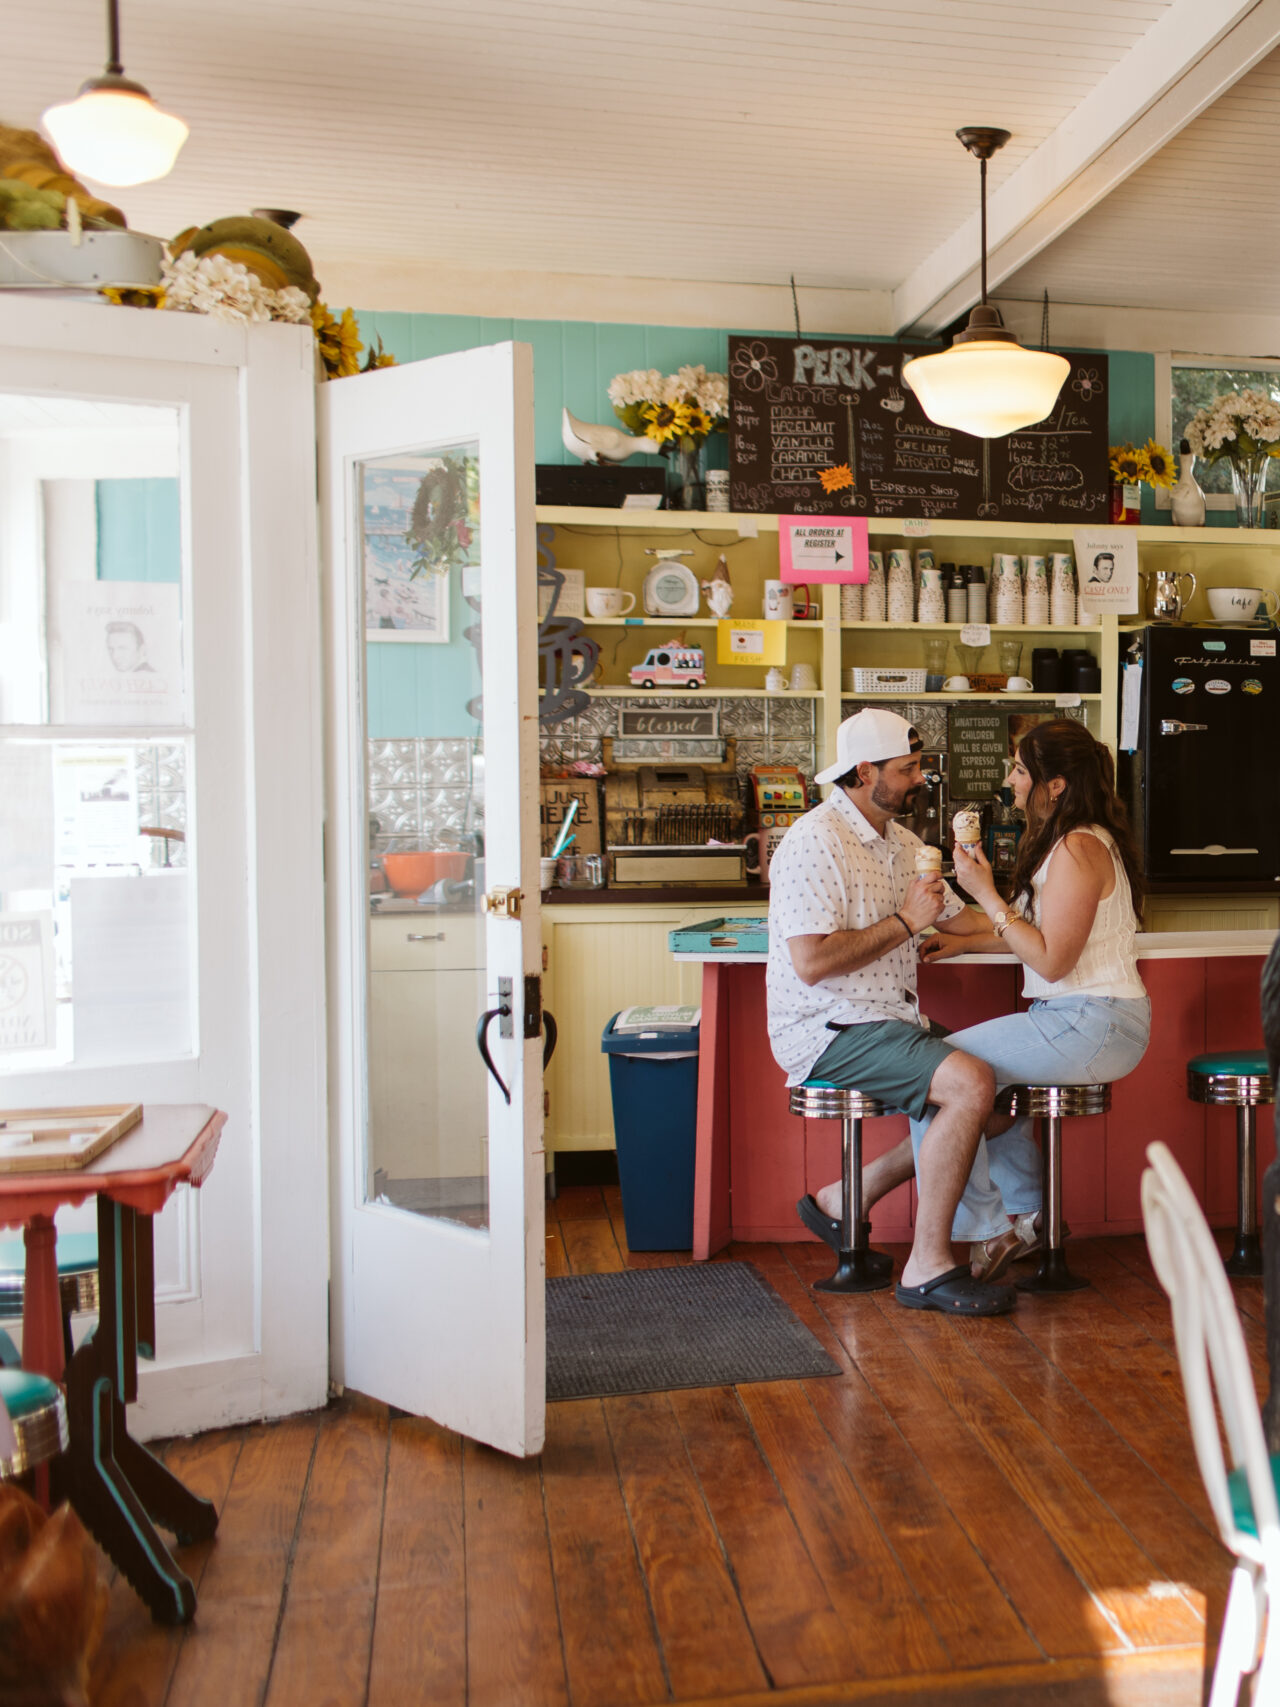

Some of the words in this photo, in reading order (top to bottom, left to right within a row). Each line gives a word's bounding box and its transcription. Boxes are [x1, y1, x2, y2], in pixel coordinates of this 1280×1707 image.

[766, 382, 837, 406] LATTE
[770, 405, 815, 417] MOCHA
[771, 436, 834, 448] VANILLA
[771, 450, 834, 463] CARAMEL
[771, 467, 817, 480] CHAI
[795, 529, 806, 537] ALL
[808, 529, 835, 537] ORDERS
[836, 529, 844, 537] AT
[804, 539, 836, 548] REGISTER
[1084, 586, 1105, 595] CASH
[1107, 585, 1131, 594] ONLY
[1174, 657, 1260, 666] Frigidaire
[636, 717, 699, 733] blessed
[955, 718, 1000, 727] UNATTENDED
[961, 731, 994, 740] CHILDREN
[953, 744, 970, 752] WILL
[972, 744, 980, 752] BE
[982, 744, 1003, 752] GIVEN
[961, 757, 995, 765] ESPRESSO
[959, 770, 973, 778] AND
[975, 770, 981, 778] A
[982, 769, 999, 778] FREE
[967, 782, 991, 791] KITTEN
[548, 791, 589, 808] JUST
